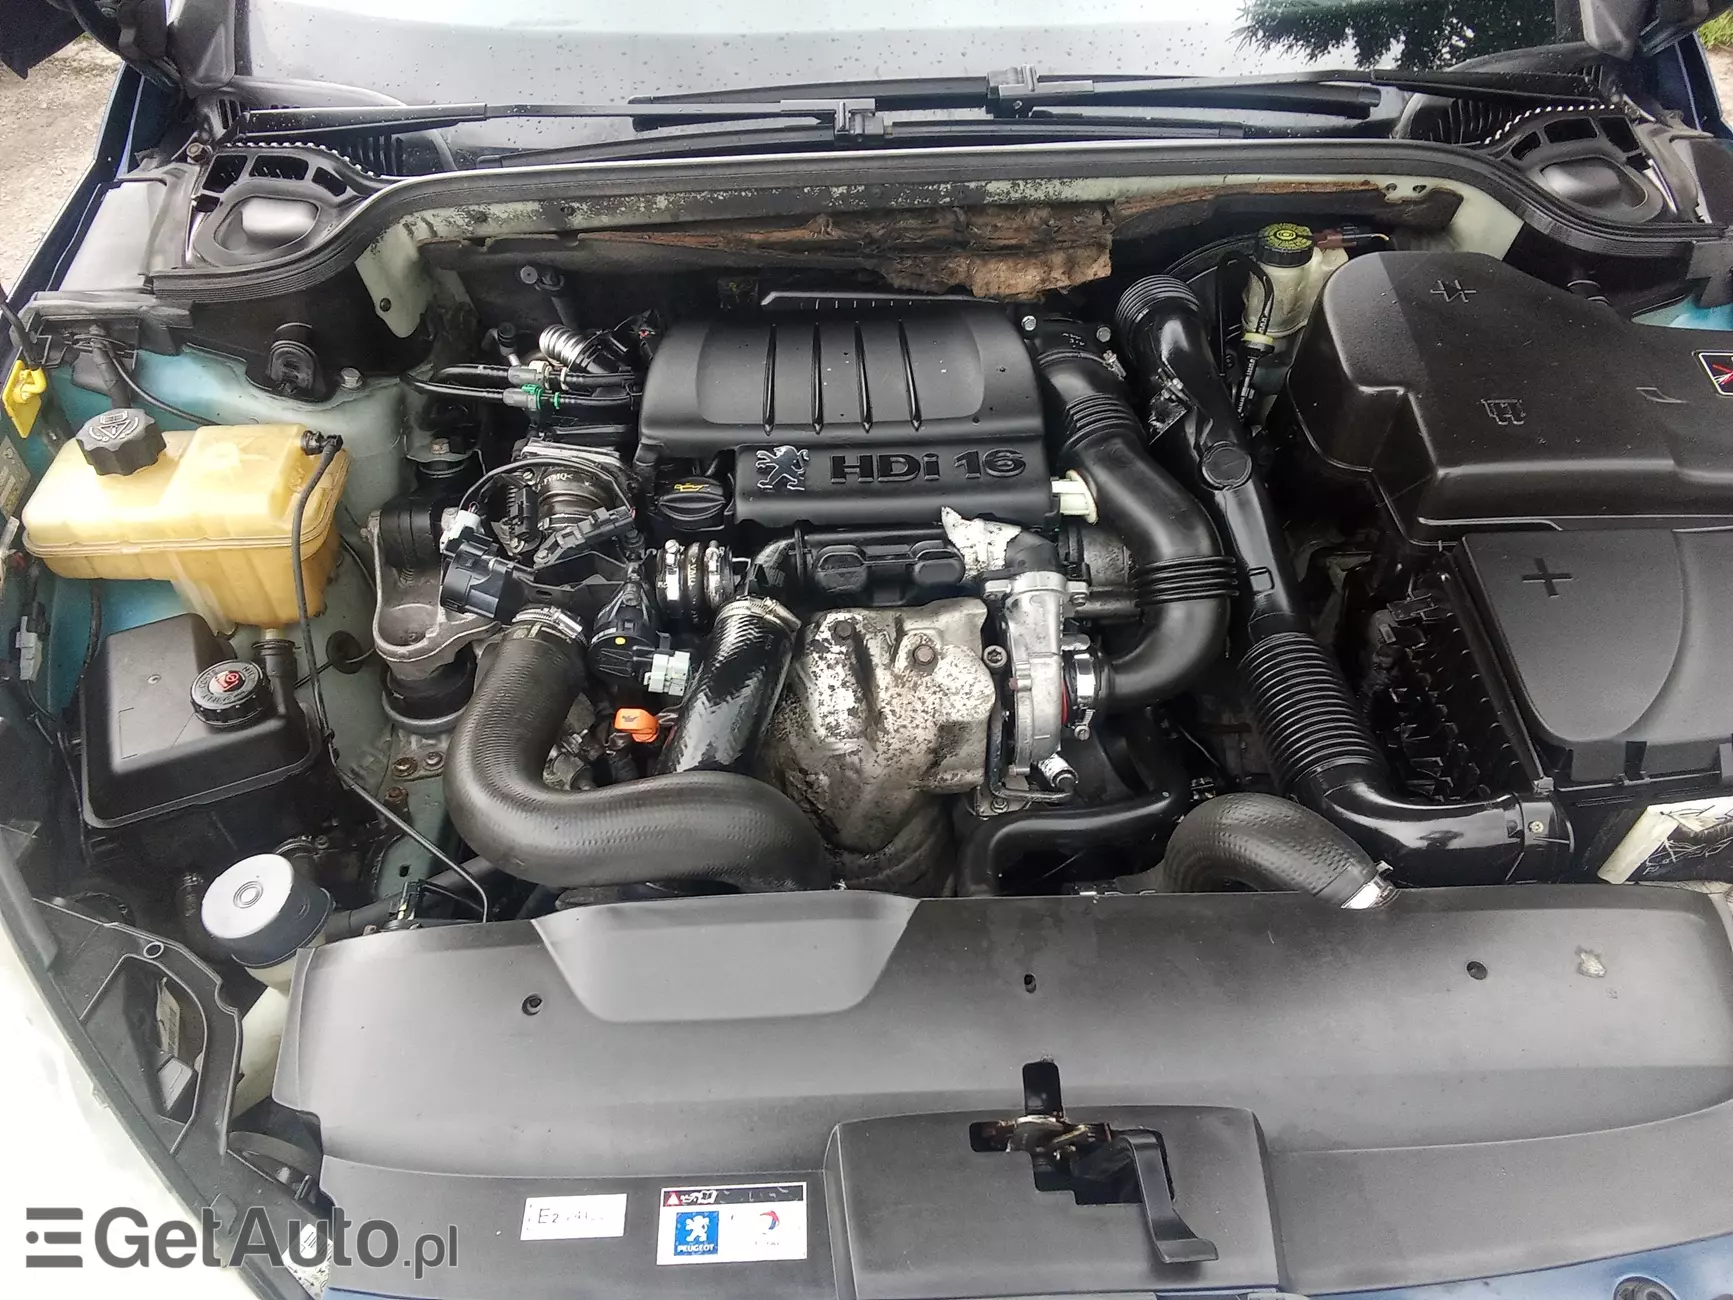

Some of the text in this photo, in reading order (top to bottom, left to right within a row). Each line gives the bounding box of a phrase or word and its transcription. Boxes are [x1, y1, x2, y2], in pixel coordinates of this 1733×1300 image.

[830, 448, 1026, 484] HDi 16
[677, 1243, 715, 1253] PEUGEOT
